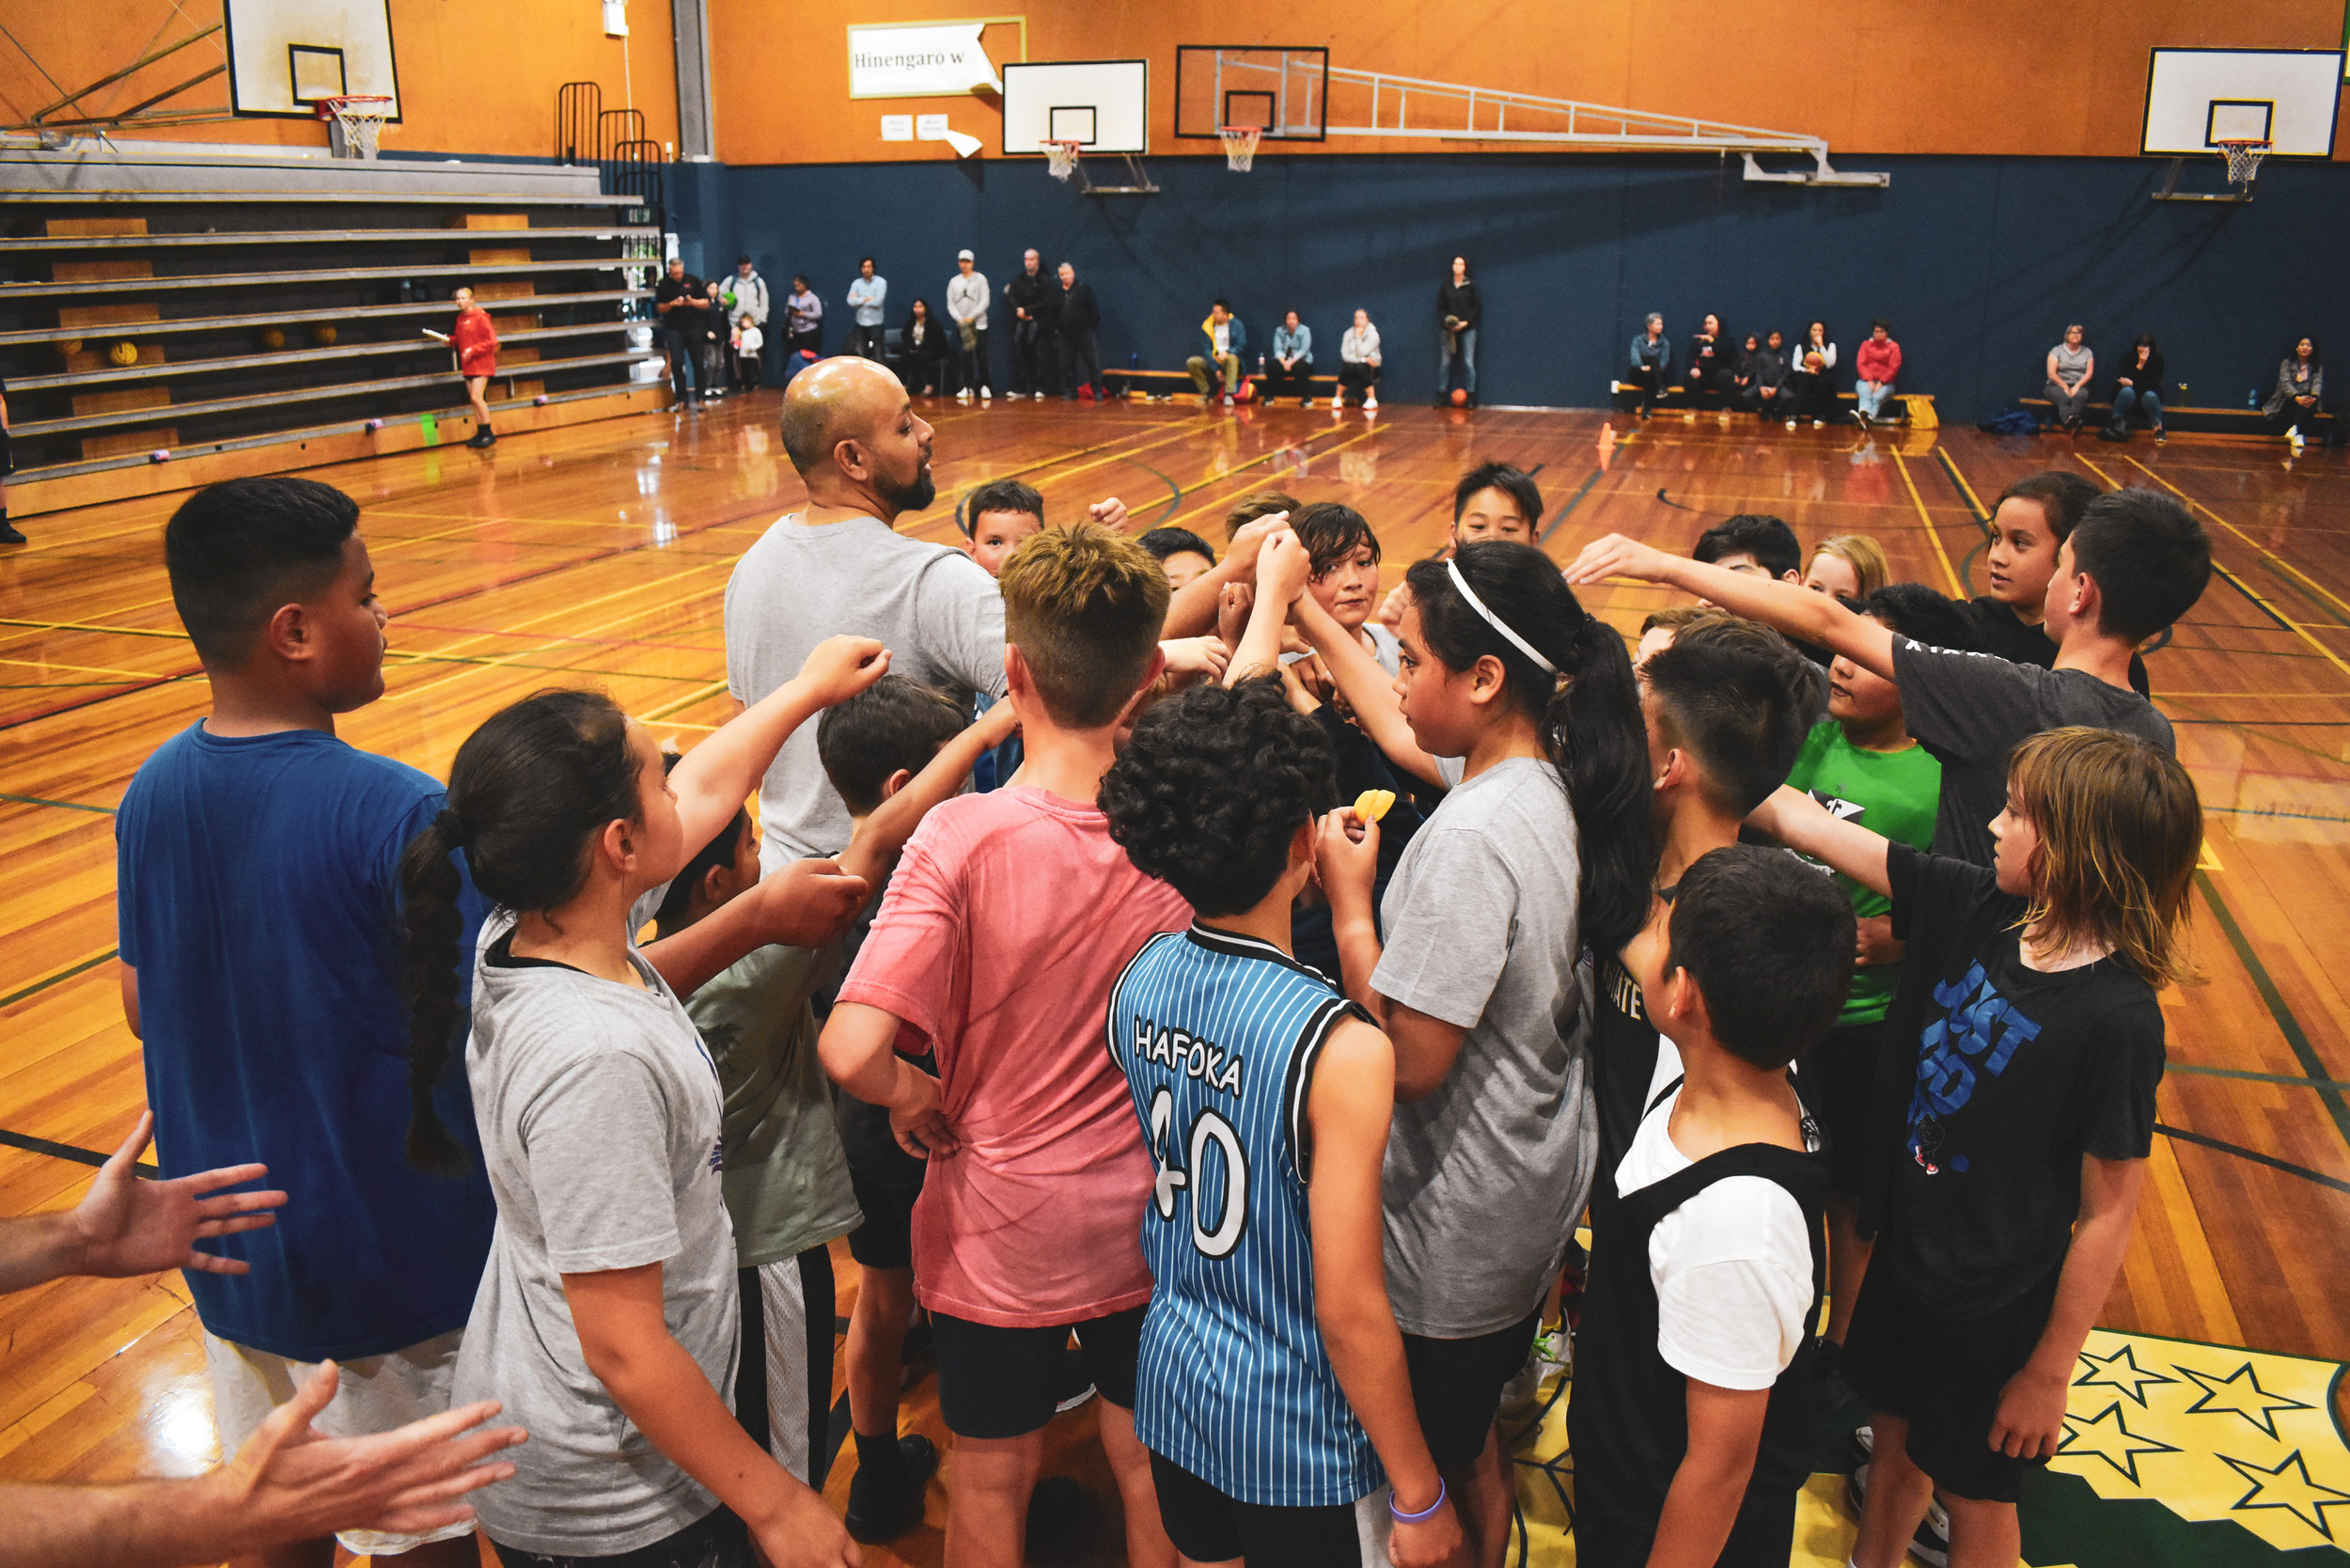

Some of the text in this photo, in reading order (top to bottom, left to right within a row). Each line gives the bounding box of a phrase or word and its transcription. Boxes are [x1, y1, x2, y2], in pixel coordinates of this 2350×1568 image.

[854, 52, 946, 71] Hinengaro
[1134, 1014, 1244, 1100] HAFOKA
[1150, 1085, 1251, 1261] 40
